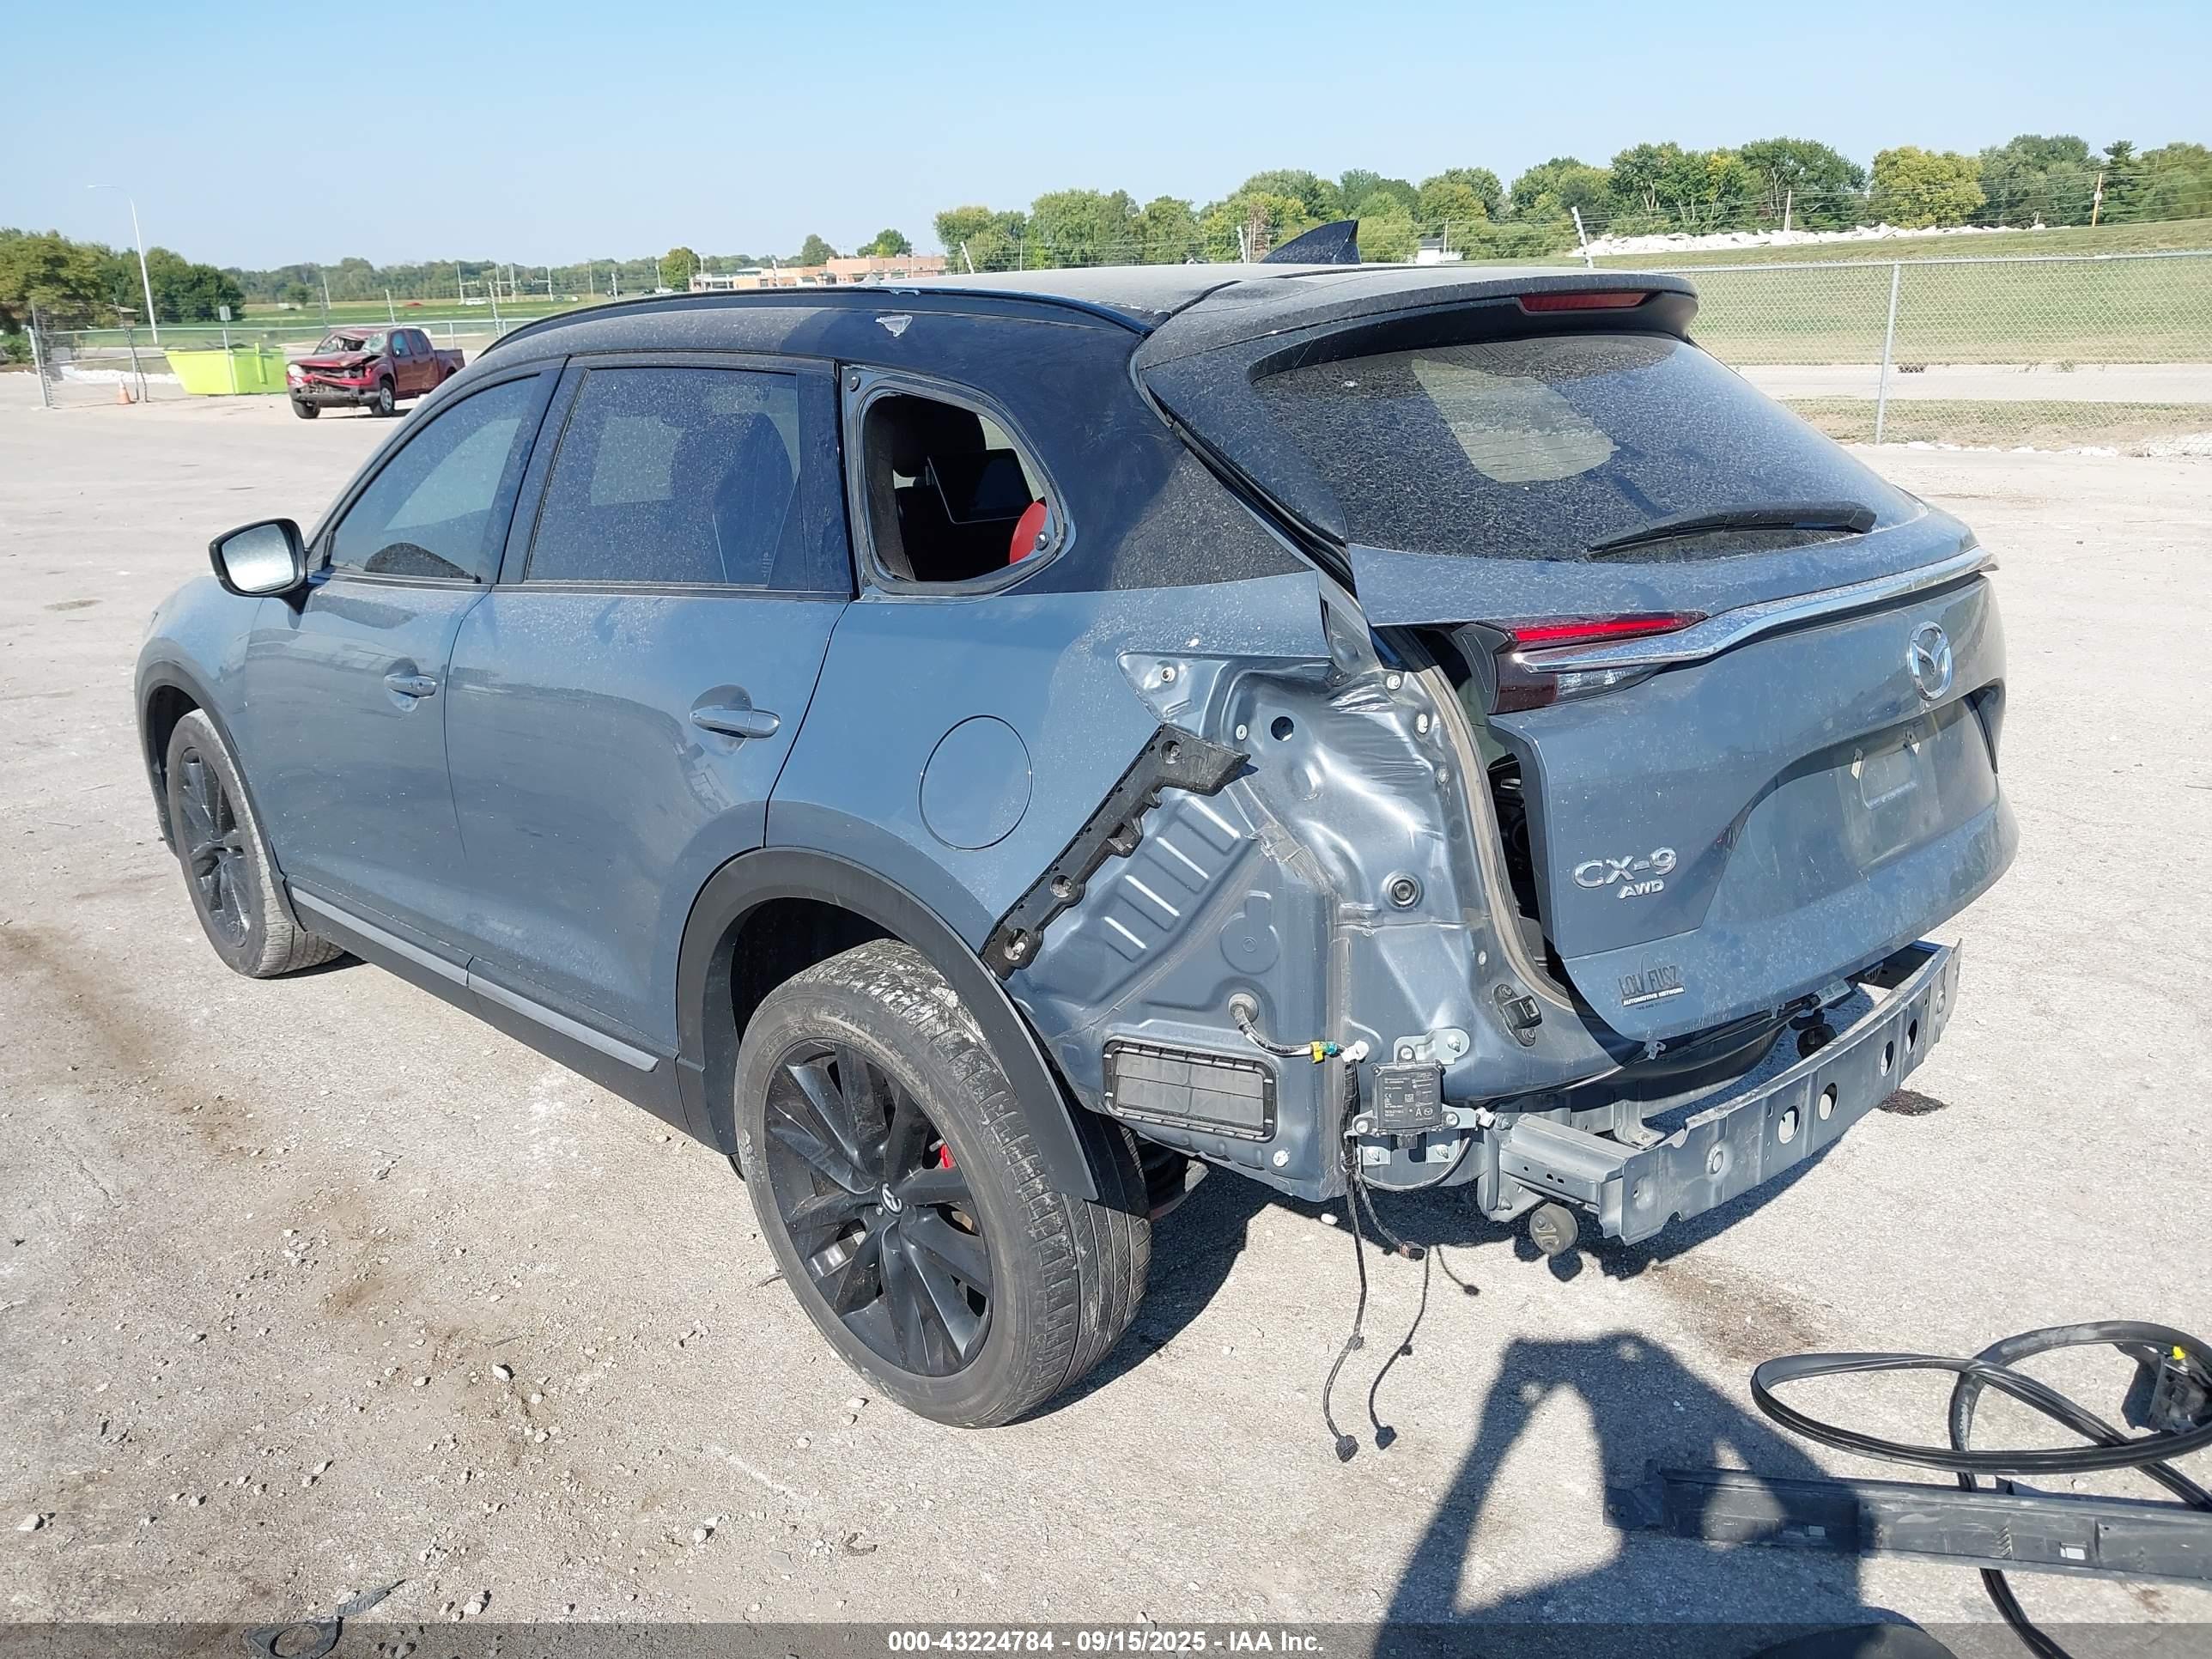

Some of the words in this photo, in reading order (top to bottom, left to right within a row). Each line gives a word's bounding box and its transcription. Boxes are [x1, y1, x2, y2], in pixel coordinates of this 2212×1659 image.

[1573, 847, 1677, 889] CX-9
[1617, 878, 1665, 899] AWD
[1618, 972, 1646, 998] LOU
[1647, 965, 1677, 991] FUSZ
[1623, 992, 1658, 1006] AUTOMOTIVE
[1658, 987, 1685, 998] NETWORK
[1415, 1107, 1422, 1117] A
